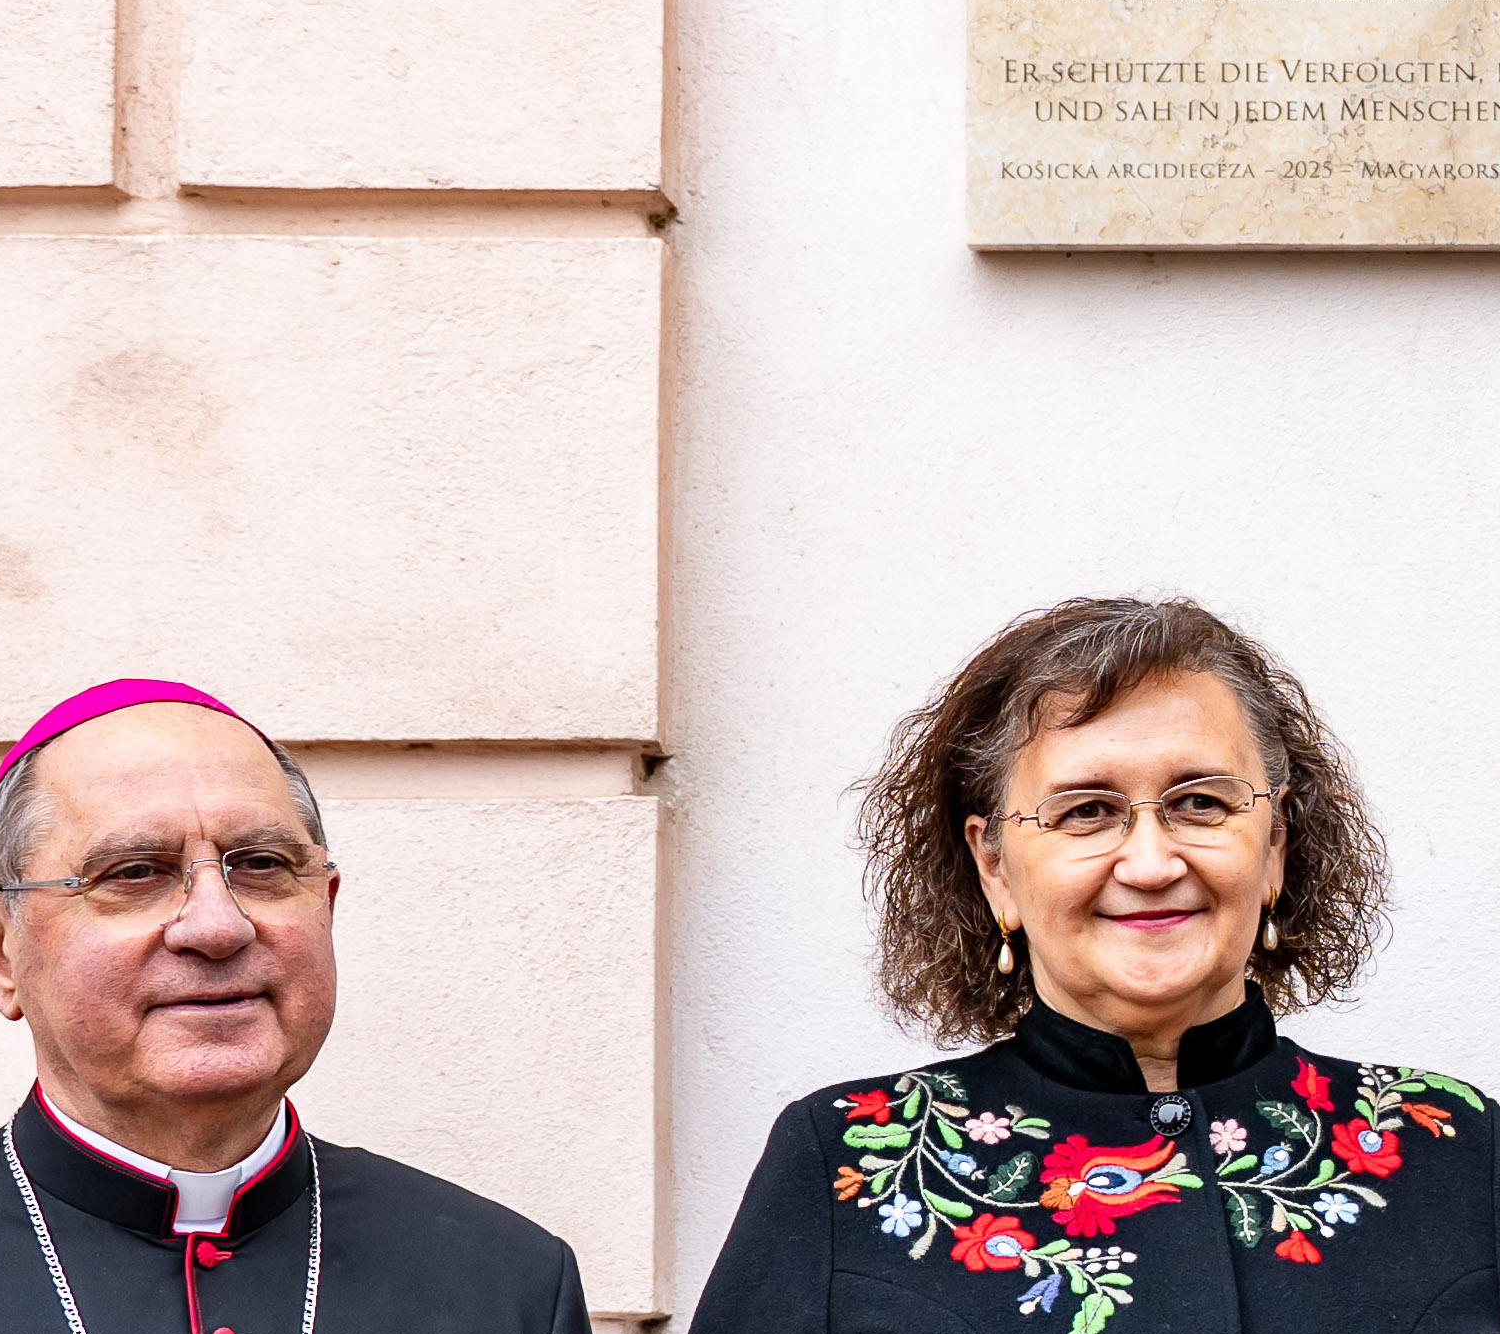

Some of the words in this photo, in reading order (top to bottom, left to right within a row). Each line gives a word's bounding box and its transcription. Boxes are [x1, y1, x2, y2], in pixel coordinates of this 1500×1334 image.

[1004, 59, 1040, 83] ER
[1051, 58, 1206, 83] SCHÜTZTE
[1220, 62, 1269, 83] DIE
[1279, 59, 1484, 85] VERFOLGTEN,
[1034, 100, 1104, 122] UND
[1115, 100, 1172, 122] SAH
[1187, 101, 1220, 122] IN
[1232, 101, 1326, 126] JEDEM
[1000, 160, 1099, 180] KOŠICKÁ
[1281, 160, 1333, 180] 2025
